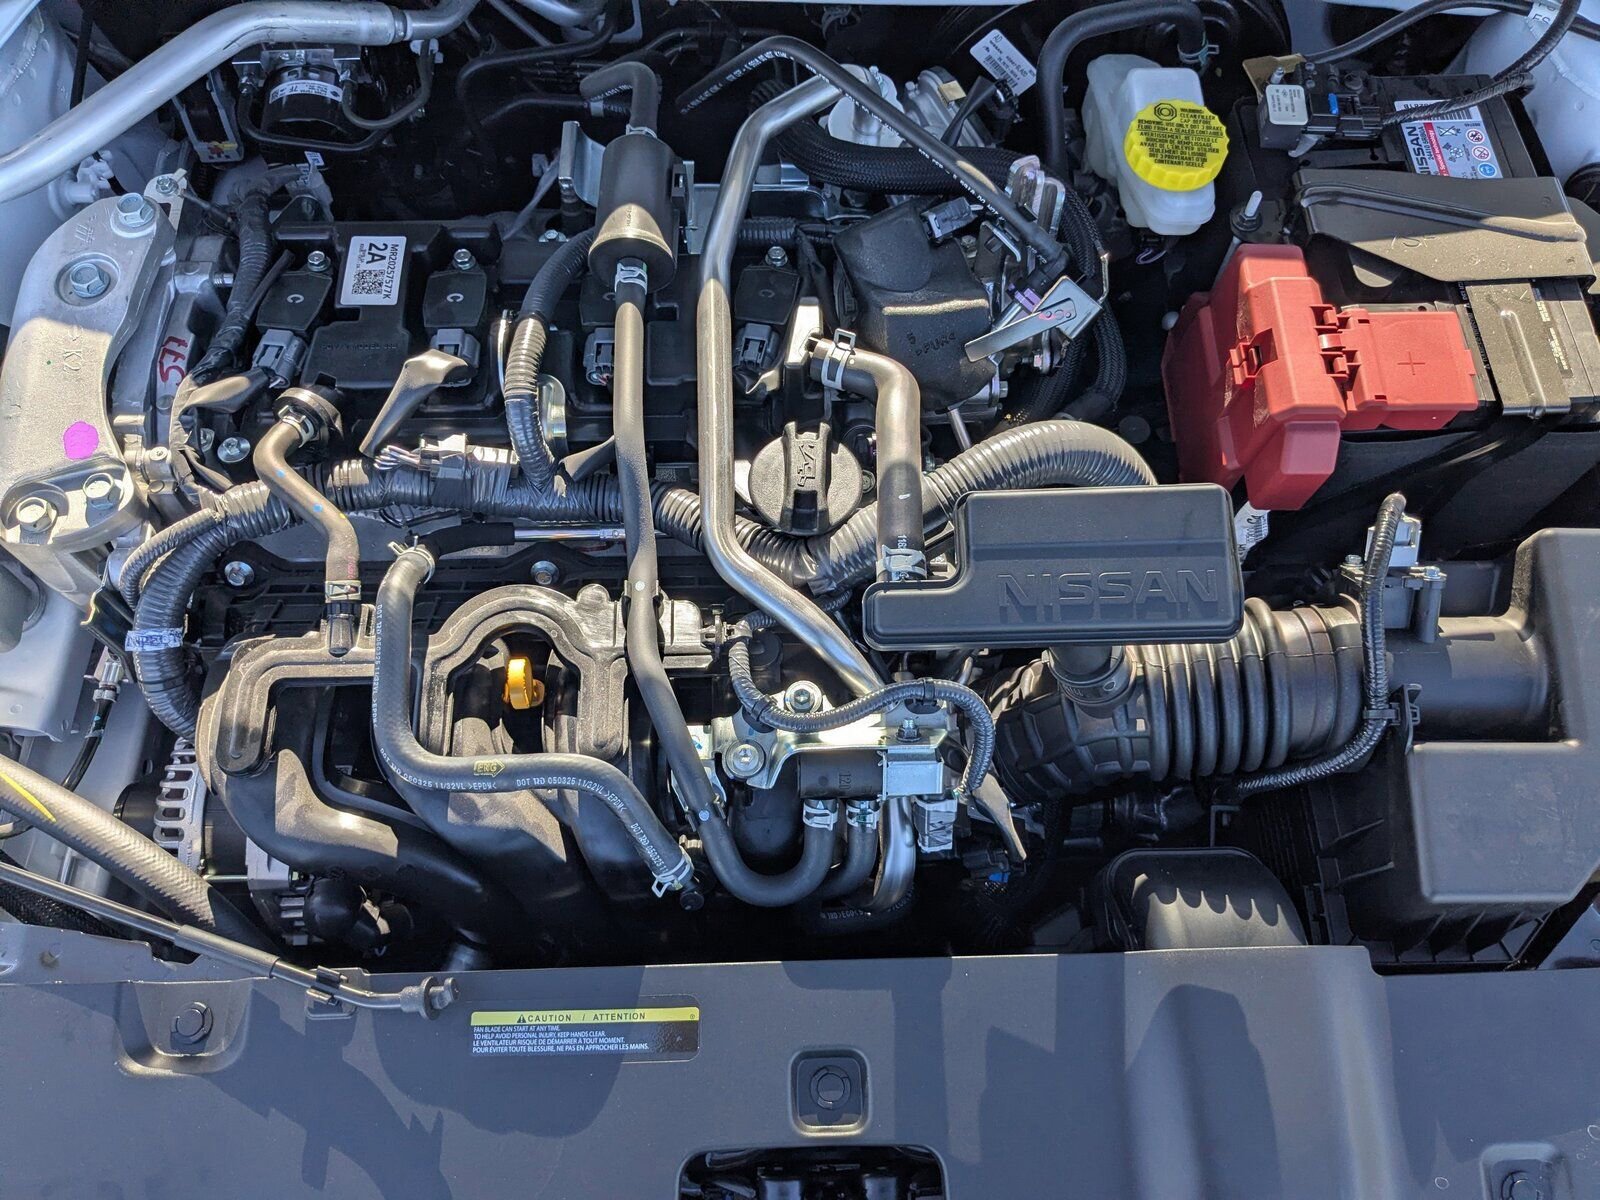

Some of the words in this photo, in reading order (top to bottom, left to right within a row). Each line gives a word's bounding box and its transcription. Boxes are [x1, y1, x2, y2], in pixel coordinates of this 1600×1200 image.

[366, 242, 388, 264] 2A
[382, 243, 399, 300] MR20257577K
[997, 569, 1218, 607] NISSAN
[477, 763, 497, 773] ENG
[528, 1014, 572, 1022] CAUTION
[593, 1012, 646, 1021] ATTENTION
[547, 1037, 577, 1045] DÉMARRER
